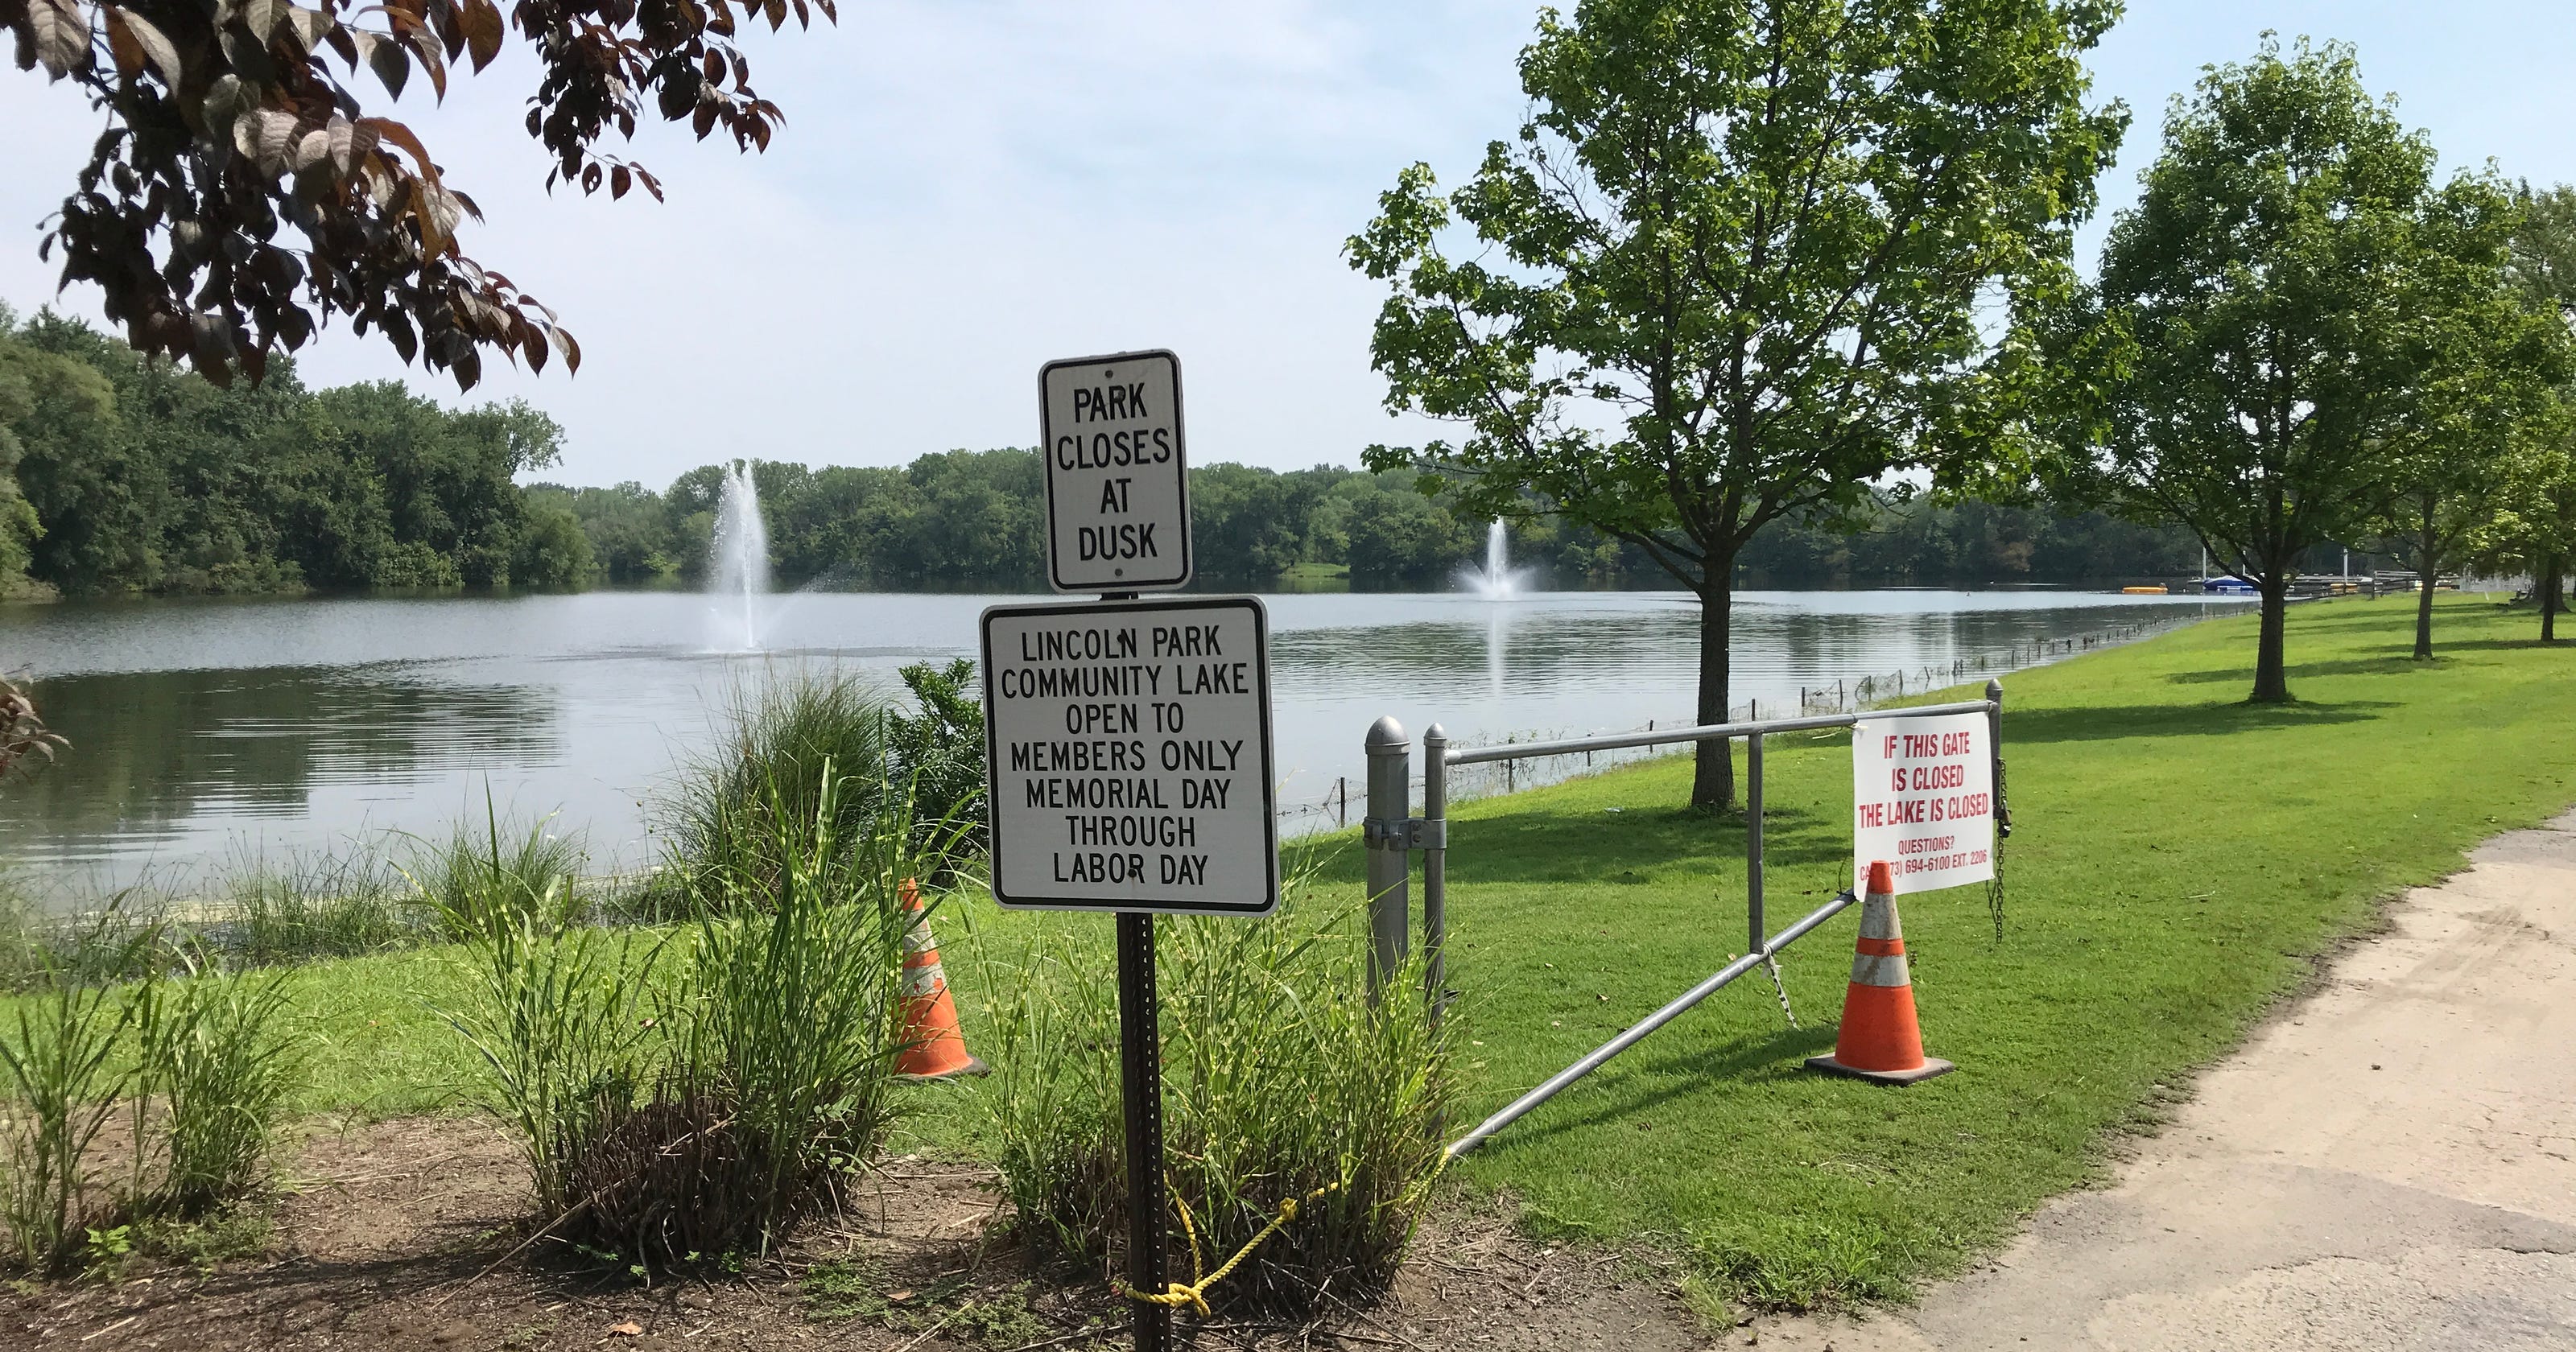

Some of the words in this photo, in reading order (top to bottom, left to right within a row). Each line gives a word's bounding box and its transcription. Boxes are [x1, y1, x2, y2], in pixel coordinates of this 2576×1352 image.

[1074, 381, 1148, 423] PARK
[1057, 427, 1170, 471] CLOSES
[1100, 477, 1132, 514] AT
[1079, 522, 1158, 562] DUSK
[1022, 628, 1137, 662] LINCOLN
[1153, 624, 1222, 657] PARK
[1001, 666, 1160, 699] COMMUNITY
[1177, 662, 1249, 695] LAKE
[1066, 703, 1137, 734] OPEN
[1151, 703, 1184, 733] TO
[1011, 740, 1146, 772] MEMBERS
[1161, 740, 1244, 772] ONLY
[1884, 735, 1897, 759] IF
[1903, 733, 1938, 758] THIS
[1942, 731, 1970, 756] GATE
[1026, 778, 1168, 809] MEMORIAL
[1183, 779, 1231, 810] DAY
[1892, 768, 1906, 792] IS
[1913, 765, 1963, 791] CLOSED
[1859, 802, 1883, 828] THE
[1887, 800, 1925, 825] LAKE
[1930, 798, 1944, 822] IS
[1947, 793, 1988, 819] CLOSED
[1065, 815, 1195, 847] THROUGH
[1898, 835, 1955, 855] QUESTIONS?
[1054, 852, 1146, 884] LABOR
[1160, 855, 1209, 886] DAY
[1887, 860, 1902, 877] 73)
[1905, 855, 1950, 874] 694-6100
[1952, 852, 1968, 868] EXT.
[1970, 849, 1988, 865] 2206
